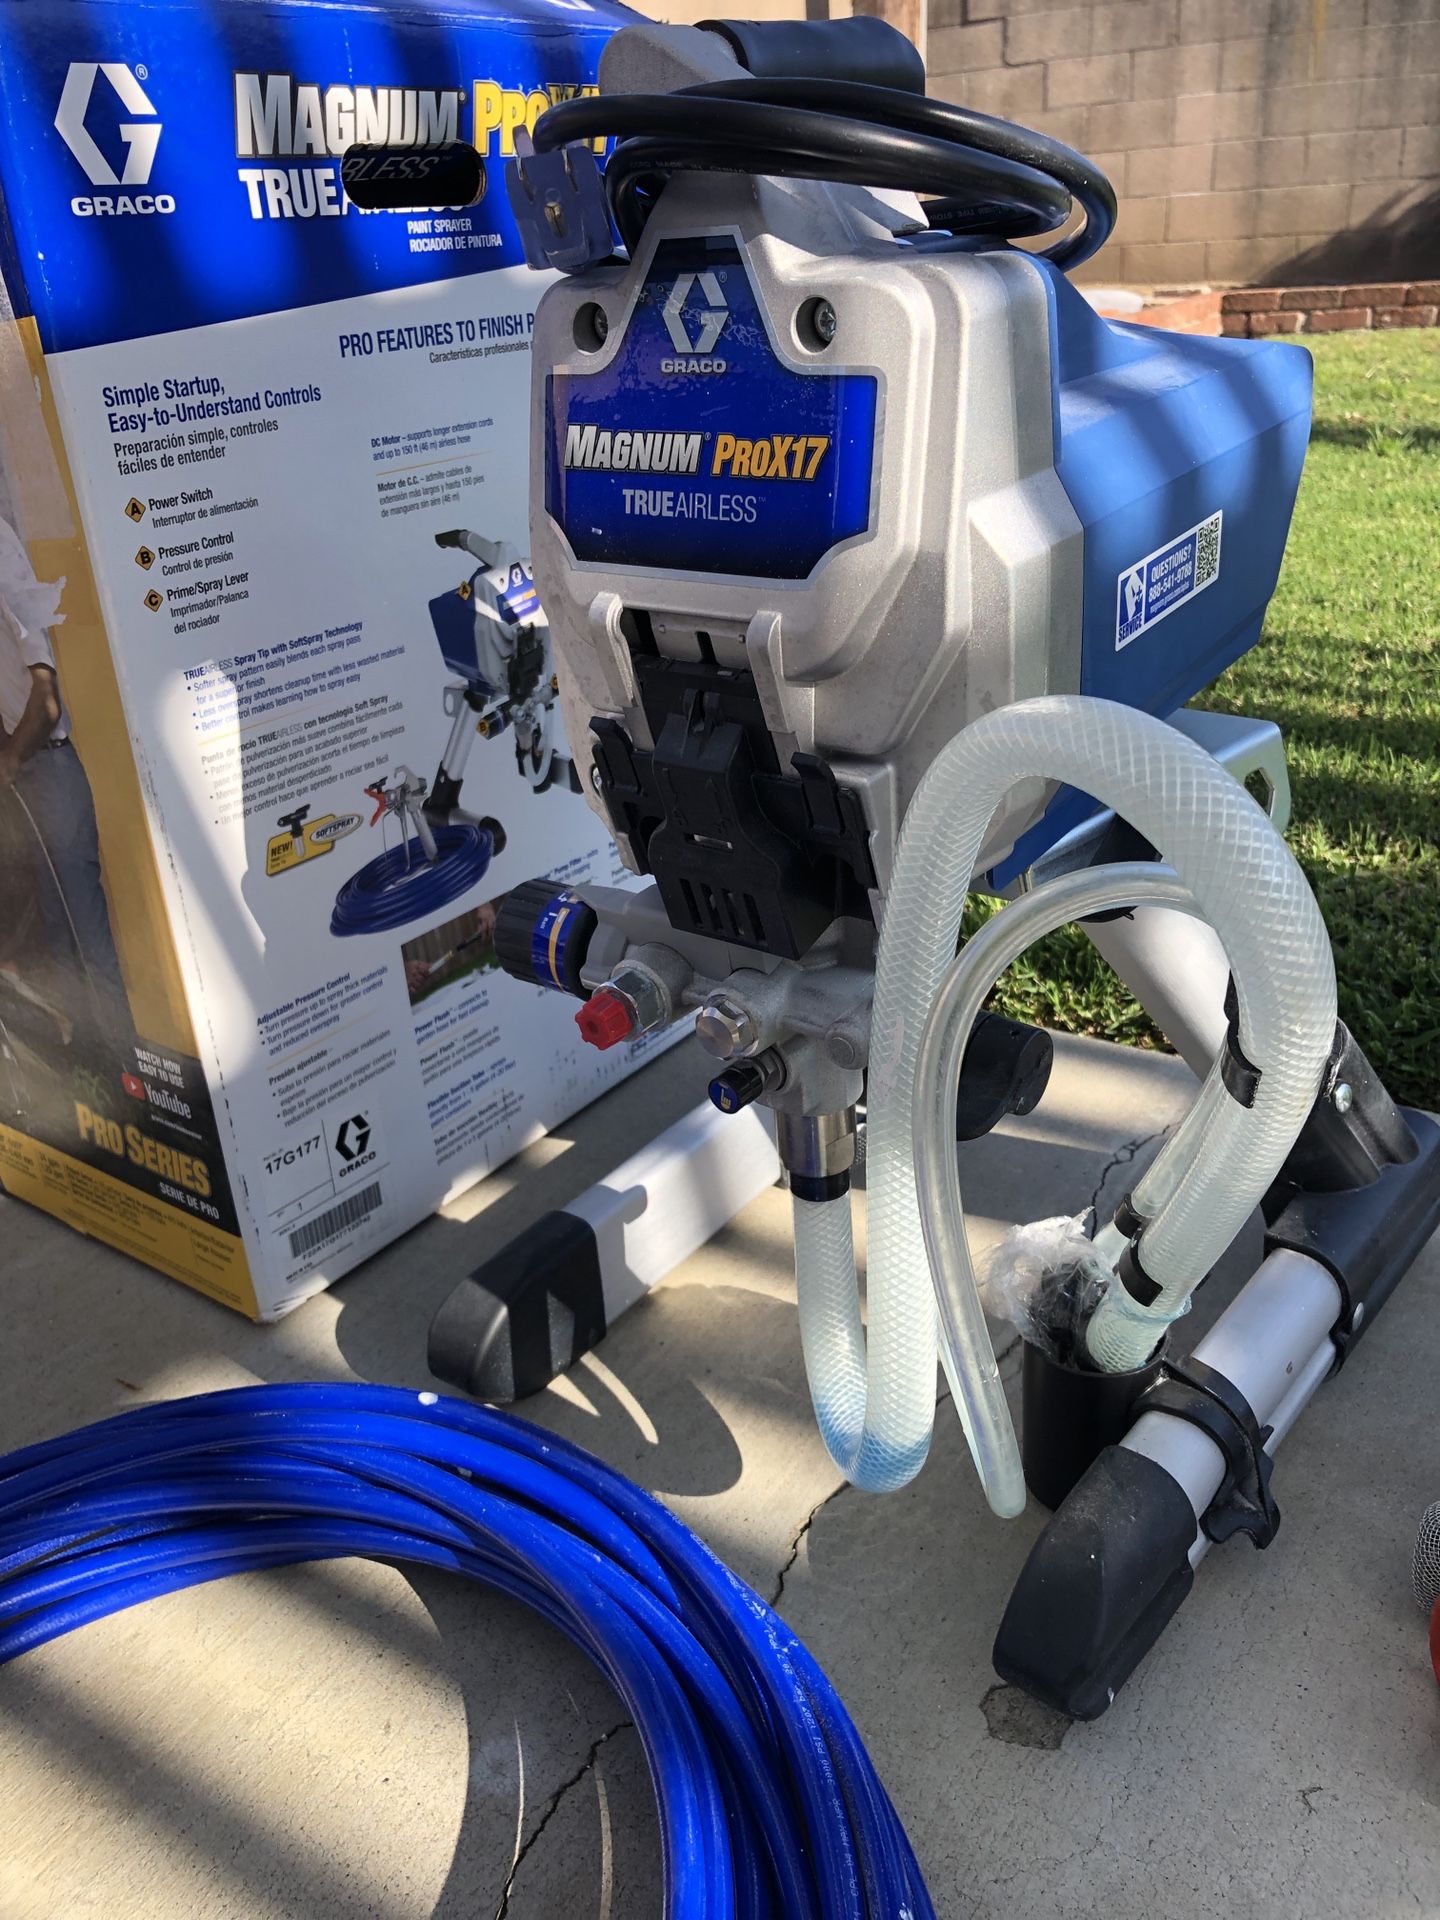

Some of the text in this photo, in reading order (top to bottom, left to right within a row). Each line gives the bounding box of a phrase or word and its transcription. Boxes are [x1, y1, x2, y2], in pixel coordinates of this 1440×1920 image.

[71, 195, 176, 217] GRACO
[407, 218, 472, 234] PAINT SPRAYER
[409, 234, 502, 252] ROCIADOR DE PINTURA
[338, 332, 373, 358] PRO
[376, 322, 453, 352] FEATURES
[456, 320, 475, 342] TO
[479, 314, 524, 340] FINISH
[661, 359, 727, 374] GRACO
[102, 376, 225, 408] Simple Startup,
[107, 384, 321, 434] Easy-to-Understand Controls
[113, 418, 278, 462] Preparación simple, controles
[381, 436, 400, 446] Motor
[117, 444, 226, 476] fáciles de entender
[131, 488, 213, 516] A Power Switch
[152, 512, 195, 528] Interruptor
[198, 508, 208, 518] de
[141, 530, 234, 565] B Pressure Control
[1151, 543, 1191, 582] QUESTIONS?
[162, 550, 233, 576] Control de presión
[149, 572, 249, 607] C Prime/Spray Lever
[170, 590, 249, 618] Imprimador/Palanca
[173, 614, 220, 634] del rociador
[1119, 613, 1143, 643] SERVICE
[234, 654, 256, 666] Spray
[257, 648, 269, 660] Tip
[271, 642, 288, 654] with
[288, 634, 323, 650] SoftSpray
[324, 622, 362, 638] Technology
[238, 664, 264, 679] pattern
[265, 658, 284, 670] easily
[285, 650, 309, 664] blends
[310, 644, 325, 656] each
[326, 640, 345, 652] spray
[346, 634, 361, 646] pass
[316, 817, 355, 839] SOFTSPRAY
[271, 841, 293, 858] NEW!
[257, 972, 350, 1026] Adjustable Pressure Control
[134, 1046, 181, 1074] WATCH HOW
[137, 1060, 184, 1088] EASY TO USE
[143, 1081, 192, 1120] YouTube
[75, 1101, 125, 1159] PRO
[124, 1123, 213, 1199] SERIES
[264, 1134, 321, 1174] 17G177
[338, 1150, 376, 1178] GRACO
[159, 1181, 220, 1221] SERIE DE PRO
